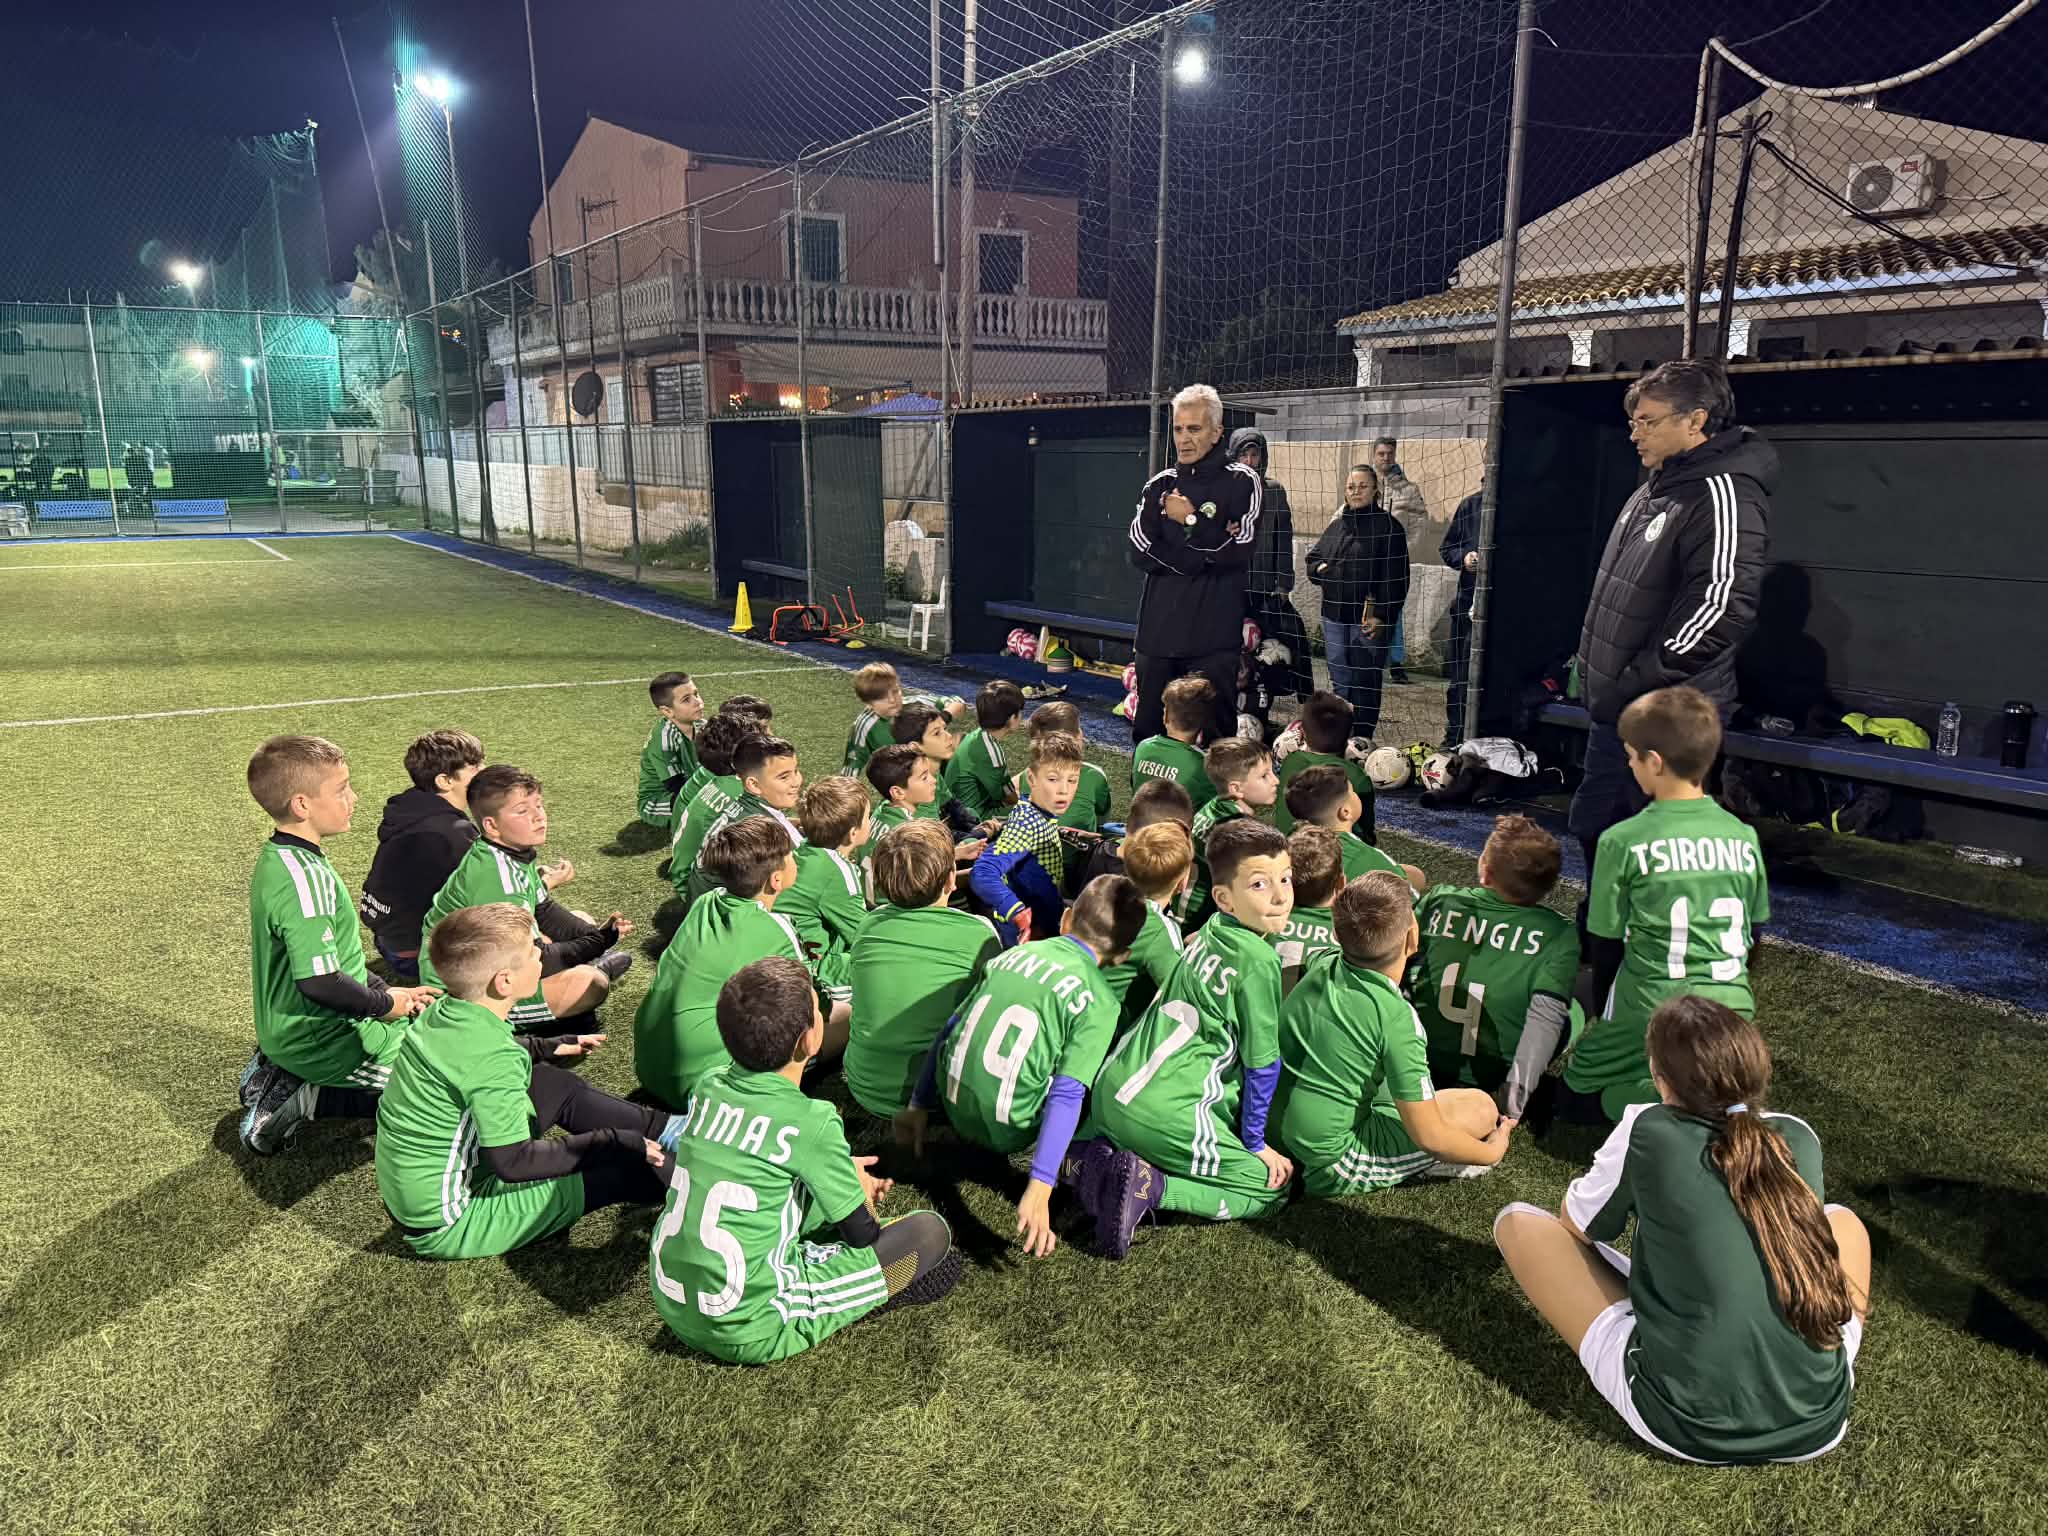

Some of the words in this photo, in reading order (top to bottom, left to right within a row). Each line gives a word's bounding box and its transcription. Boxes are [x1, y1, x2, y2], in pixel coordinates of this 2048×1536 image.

[1631, 838, 1756, 875] TSIRONIS
[1668, 896, 1747, 981] 13
[1439, 963, 1486, 1056] 4
[947, 994, 1040, 1124] 19
[653, 1166, 758, 1317] 25
